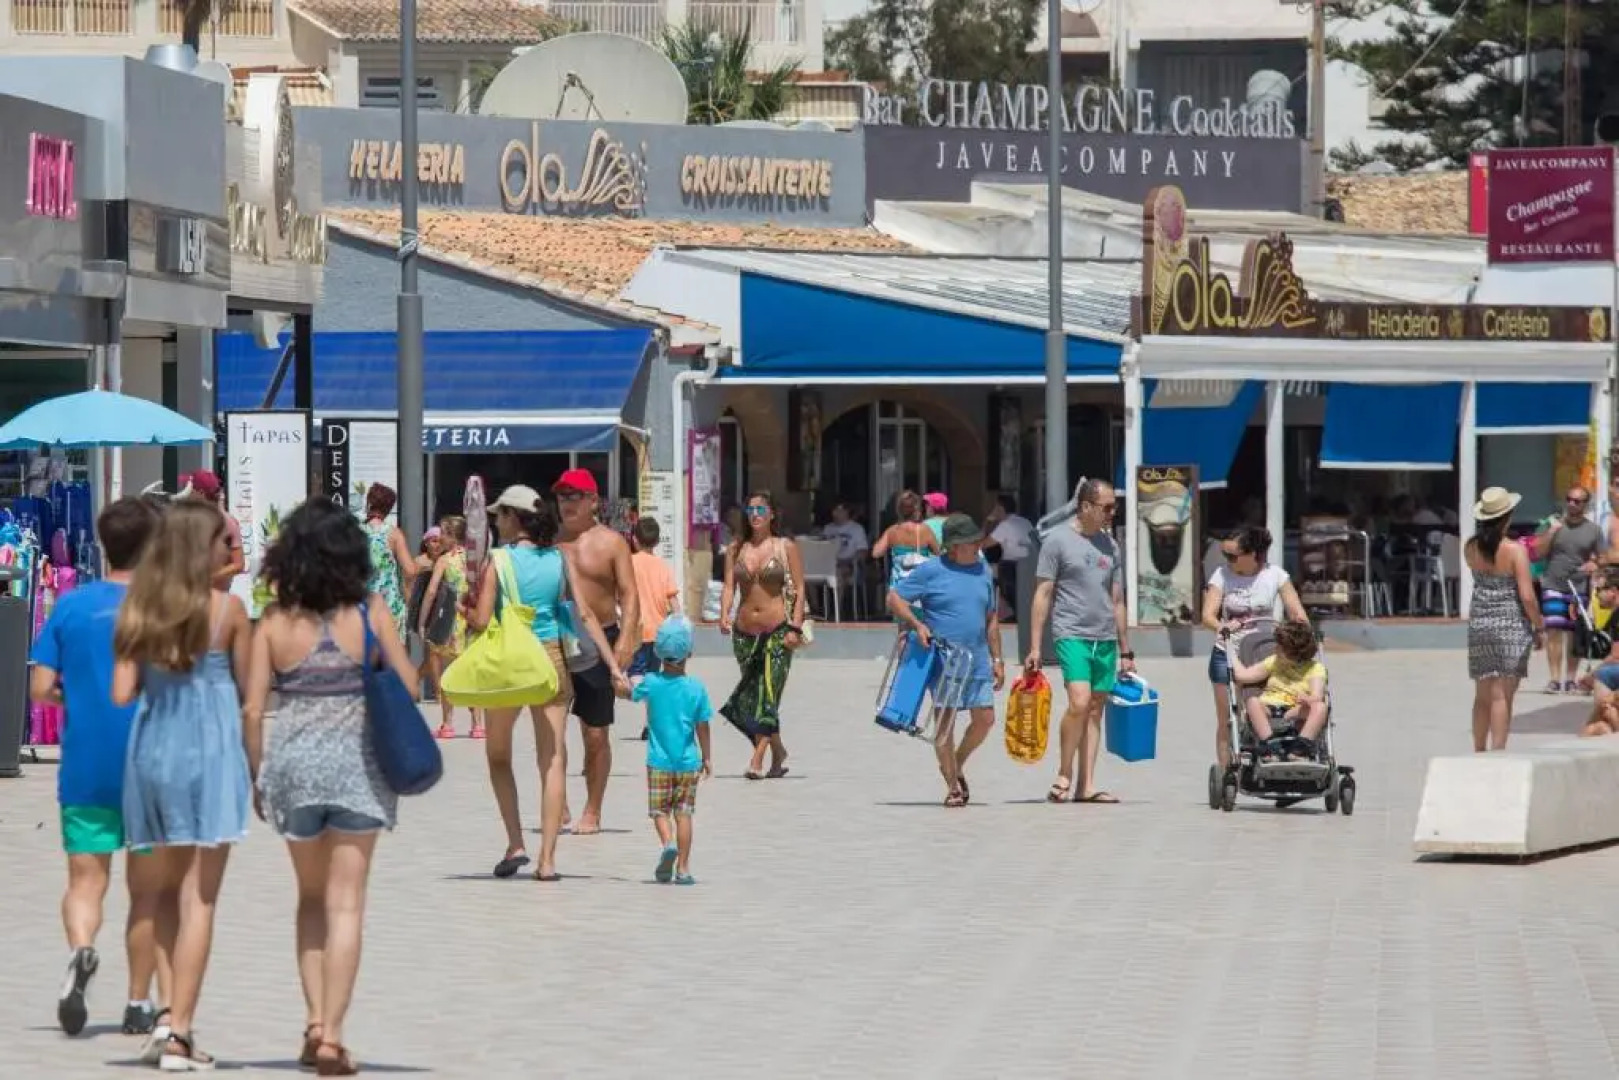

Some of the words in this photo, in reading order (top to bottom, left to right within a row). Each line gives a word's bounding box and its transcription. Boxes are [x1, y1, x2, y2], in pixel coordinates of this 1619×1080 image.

[863, 86, 907, 126] Bar
[923, 79, 1155, 134] CHAMPAGNE
[1172, 95, 1296, 139] Cocktails
[350, 138, 464, 184] HELAERIA
[681, 154, 833, 198] CROISSANTERIE
[1495, 157, 1608, 171] JAVEACOMPANY
[1506, 179, 1594, 222] Champagne
[1501, 243, 1603, 255] RESTAURANTE
